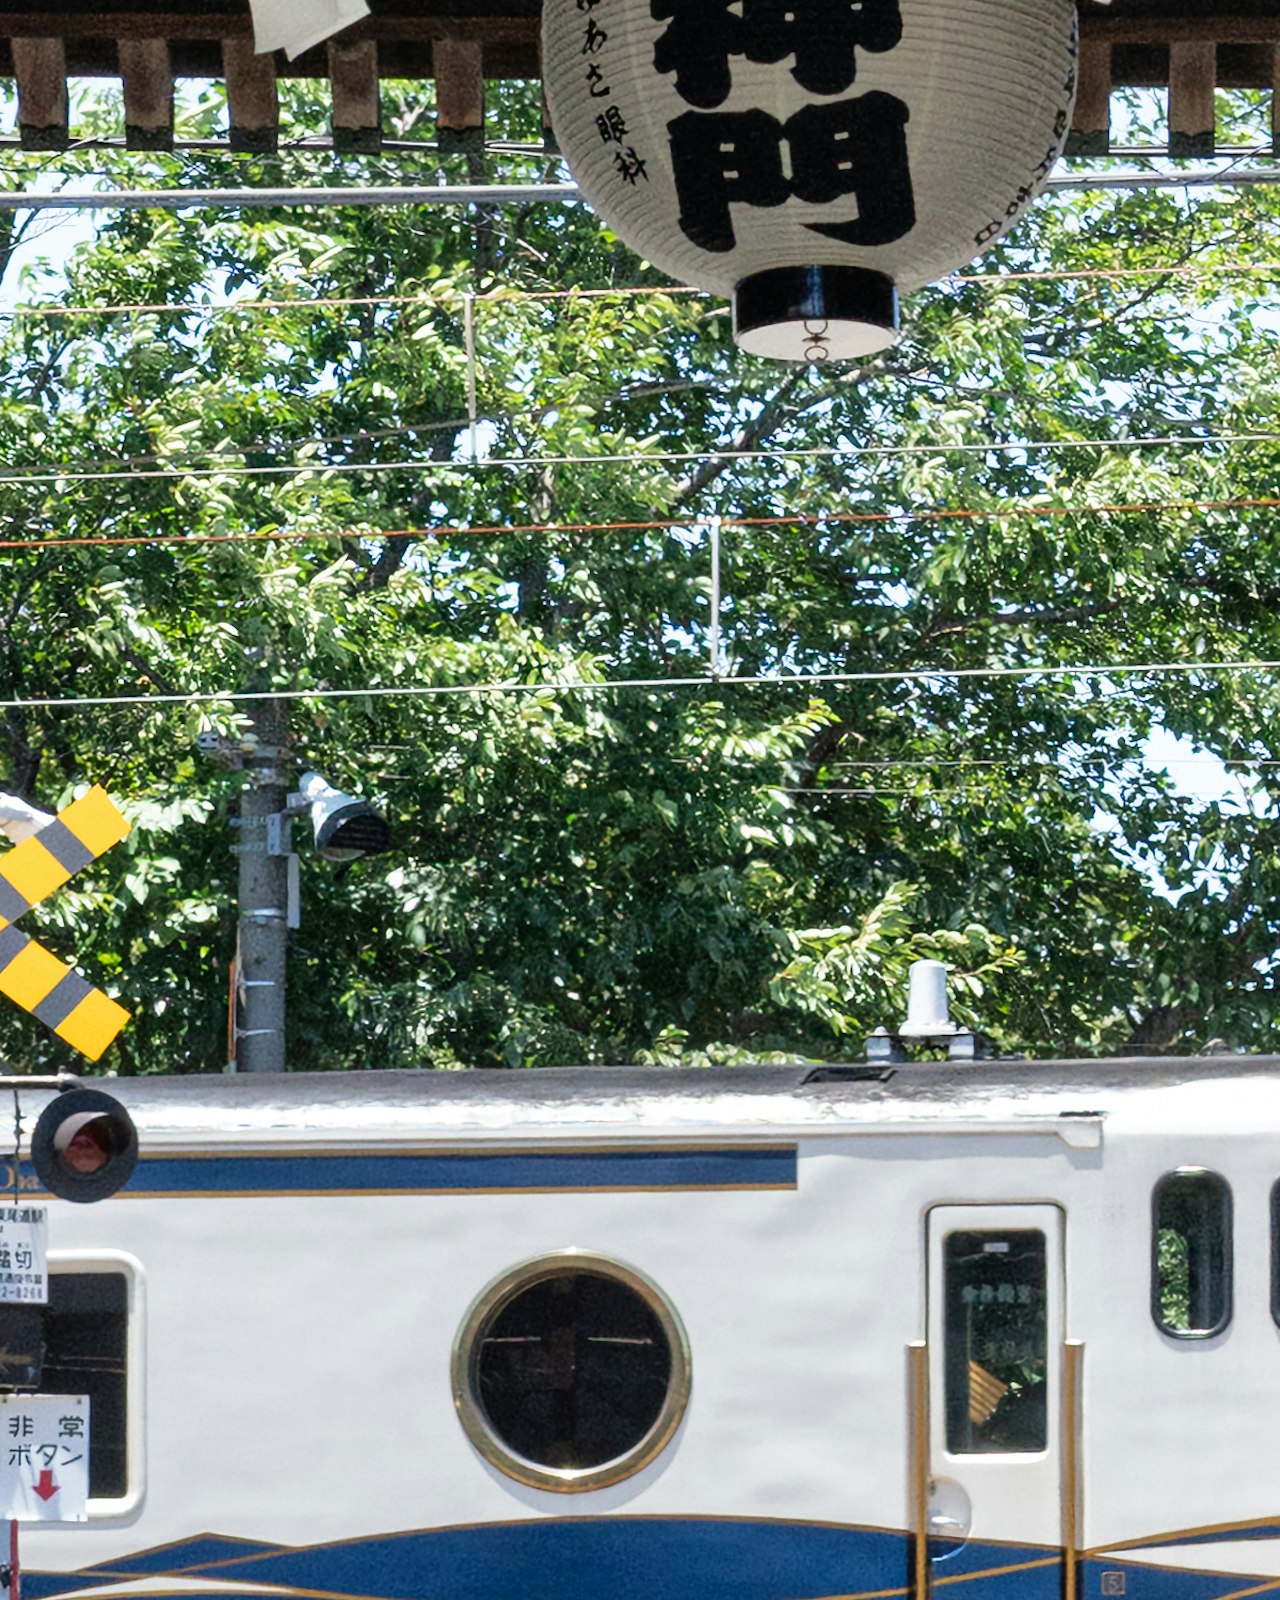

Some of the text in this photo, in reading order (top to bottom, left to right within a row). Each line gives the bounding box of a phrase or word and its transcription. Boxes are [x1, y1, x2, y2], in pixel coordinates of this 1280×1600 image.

[8, 1415, 84, 1438] 非常
[8, 1443, 83, 1467] ボタン
